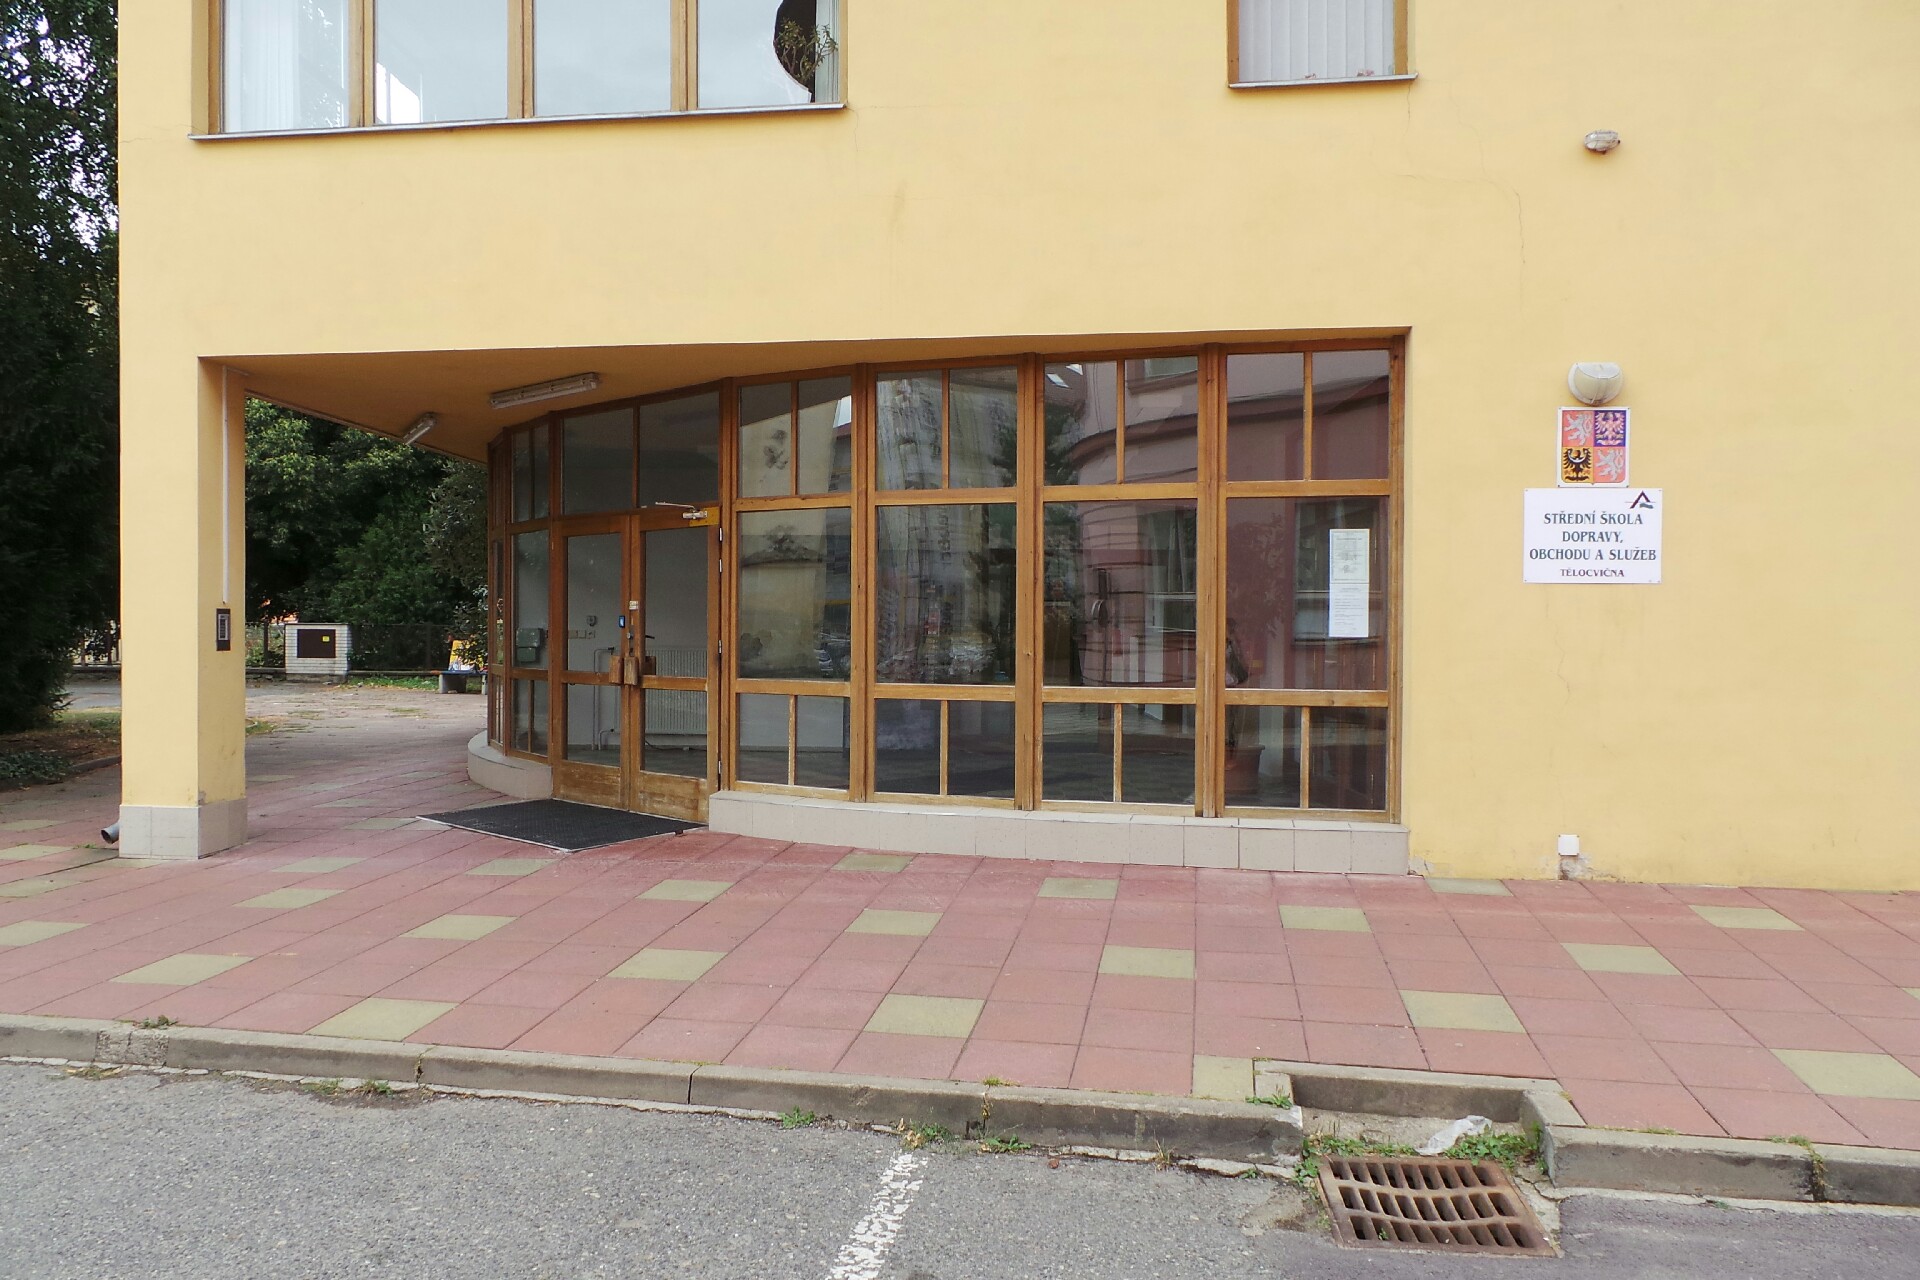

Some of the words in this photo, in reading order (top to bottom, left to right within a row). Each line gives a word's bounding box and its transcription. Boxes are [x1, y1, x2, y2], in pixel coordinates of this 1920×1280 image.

[1543, 510, 1595, 525] STŘEDNÍ
[1600, 510, 1643, 525] ŠKOLA
[1562, 531, 1624, 544] DOPRAVY,
[1529, 548, 1591, 560] OBCHODU
[1595, 549, 1604, 560] A
[1609, 546, 1657, 561] SLUŽEB
[1560, 567, 1625, 577] TĚLOCVIČNA
